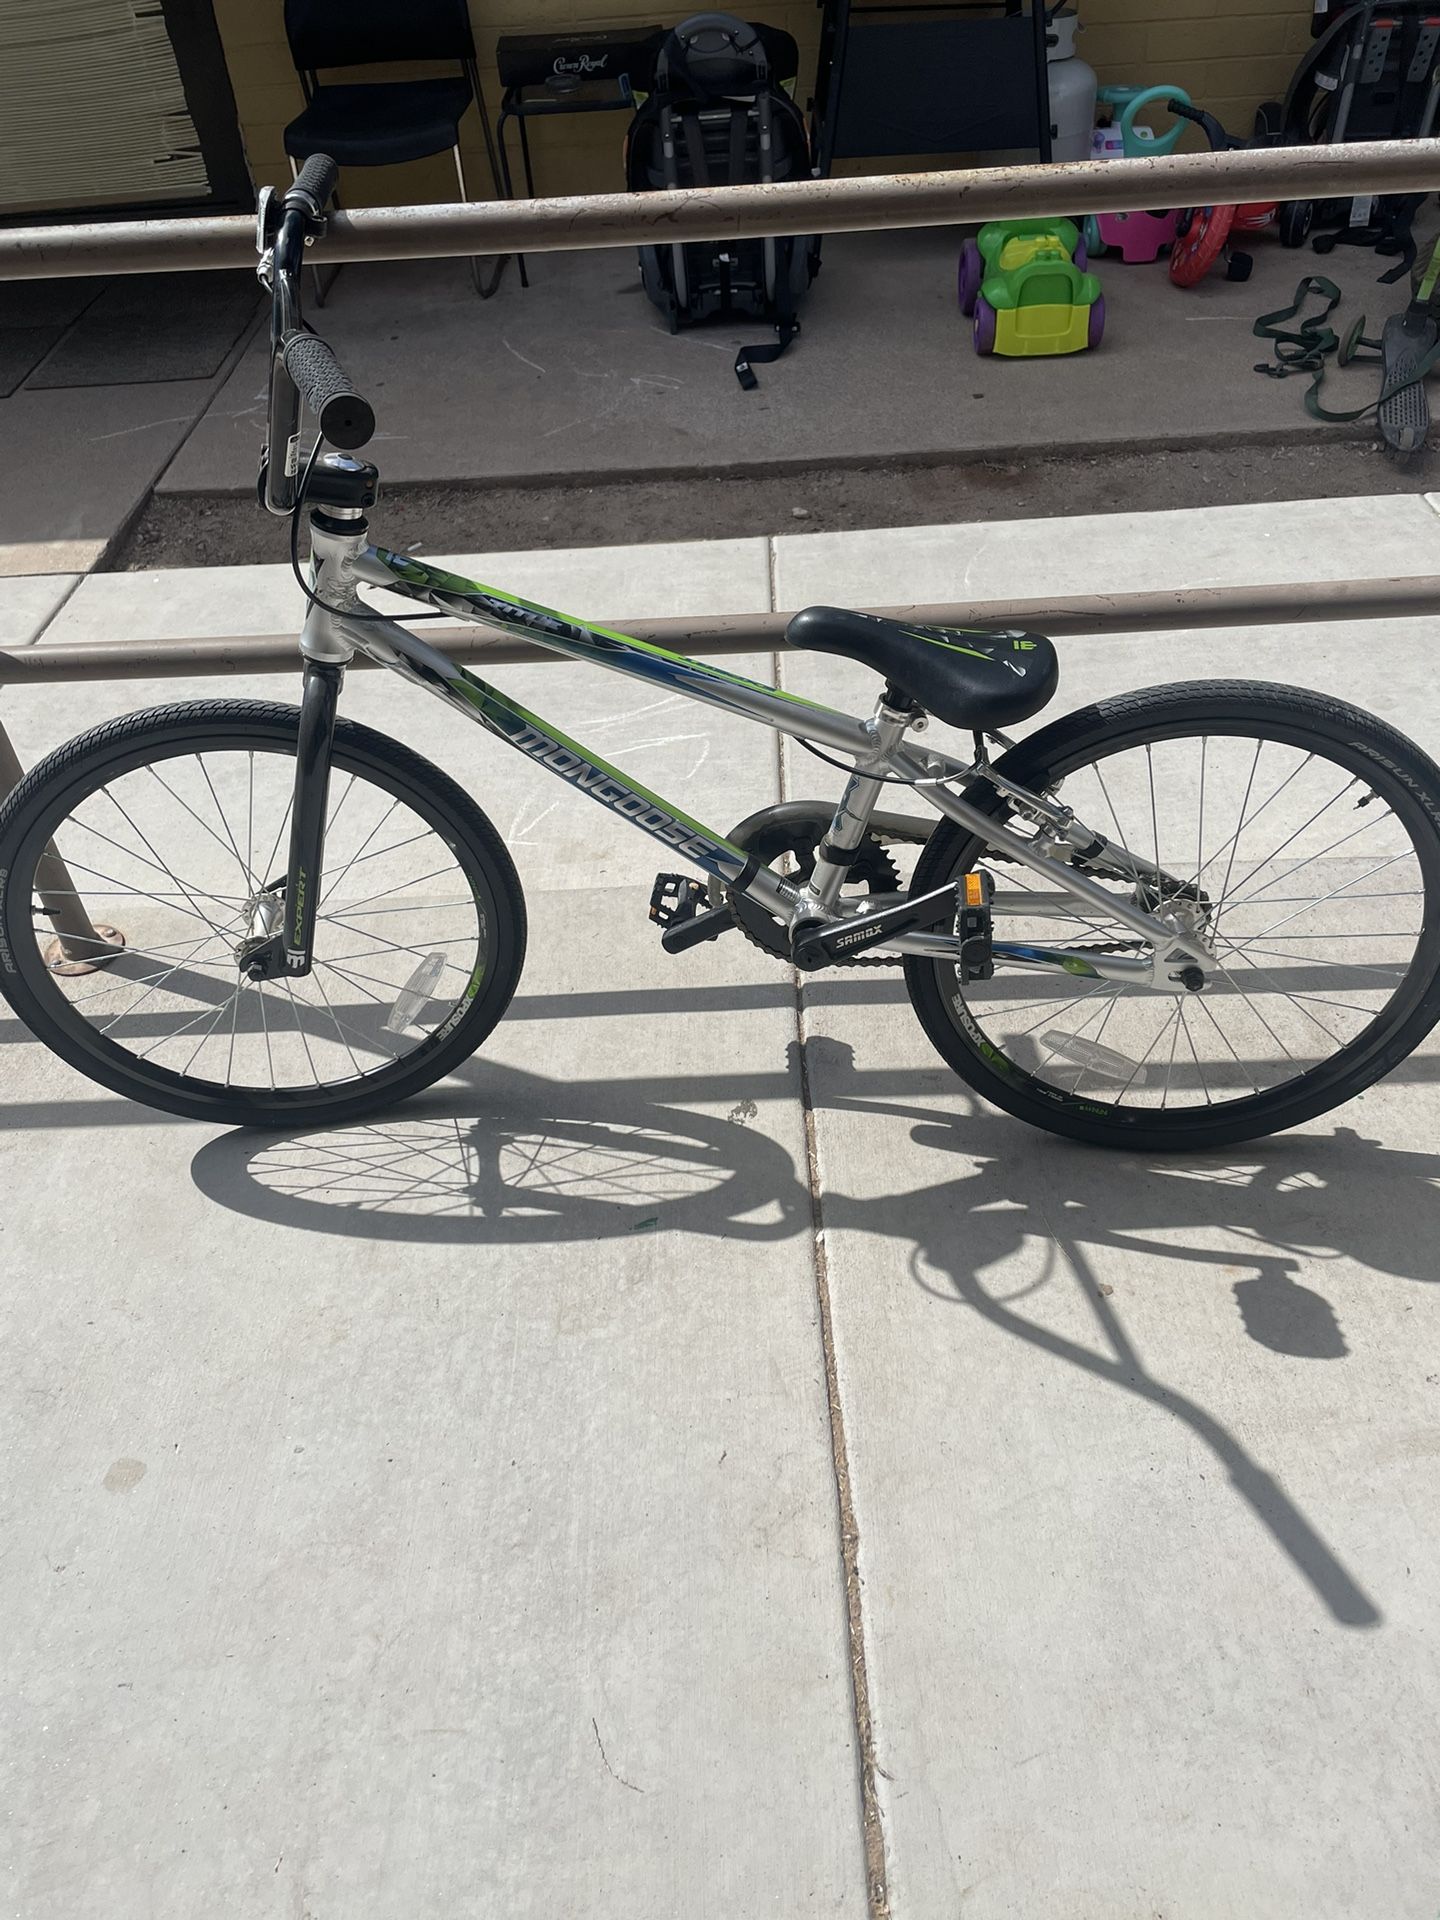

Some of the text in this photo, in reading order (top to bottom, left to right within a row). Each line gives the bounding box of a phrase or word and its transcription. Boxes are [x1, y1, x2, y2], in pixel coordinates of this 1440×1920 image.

[553, 54, 608, 74] Crown Royal
[510, 723, 718, 859] MONGOOSE
[1348, 741, 1440, 829] ARISUN XLR
[294, 866, 306, 945] EXPERT
